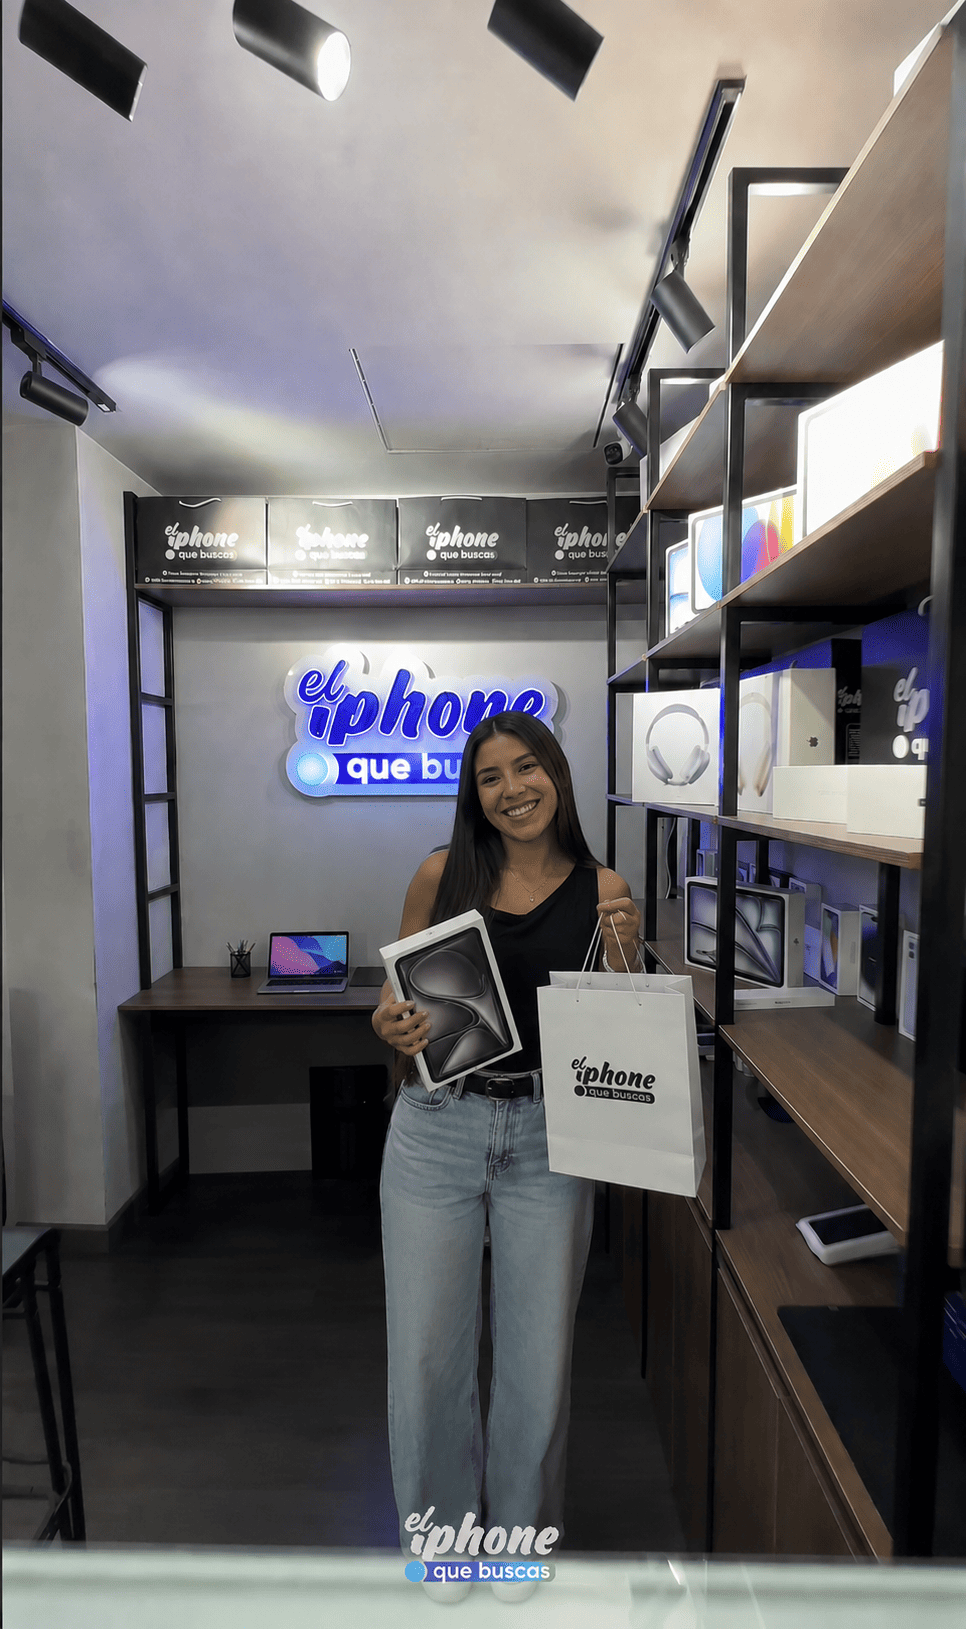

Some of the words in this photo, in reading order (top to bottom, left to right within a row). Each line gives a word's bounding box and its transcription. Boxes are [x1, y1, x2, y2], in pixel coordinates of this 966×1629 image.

[165, 522, 179, 536] el
[425, 522, 440, 536] el
[554, 523, 569, 536] el
[168, 525, 239, 550] iphone
[429, 525, 499, 550] iphone
[179, 551, 198, 560] que
[200, 549, 234, 559] buscas
[440, 551, 459, 560] que
[461, 549, 495, 559] buscas
[568, 551, 586, 560] que
[298, 659, 350, 704] el
[893, 667, 918, 702] el
[347, 757, 411, 785] que
[571, 1056, 587, 1071] el
[575, 1061, 656, 1090] iphone
[589, 1088, 610, 1097] que
[612, 1088, 651, 1102] buscas
